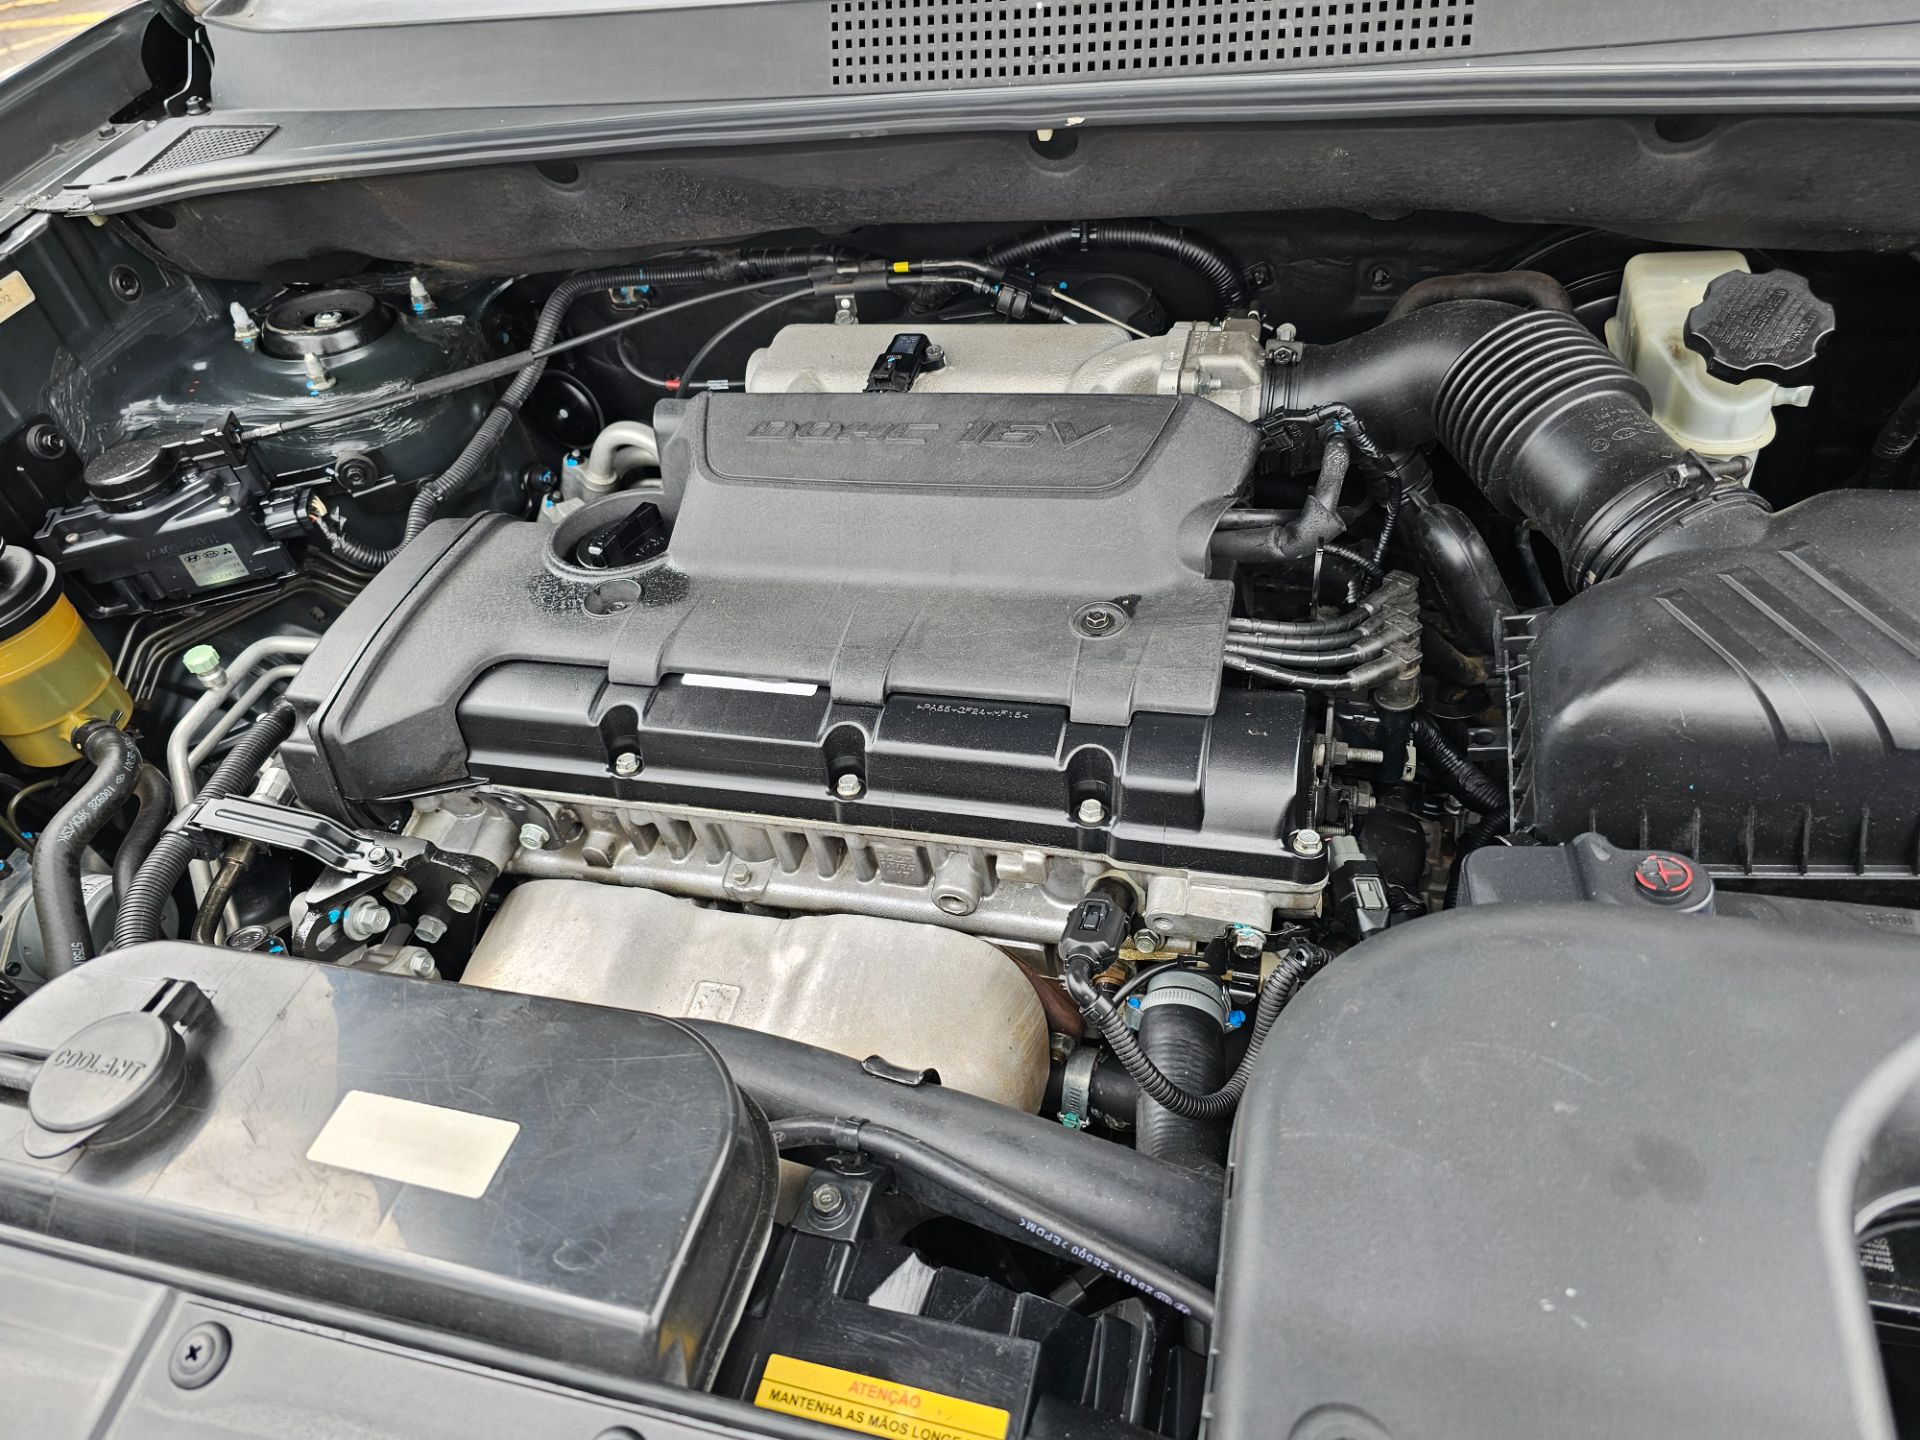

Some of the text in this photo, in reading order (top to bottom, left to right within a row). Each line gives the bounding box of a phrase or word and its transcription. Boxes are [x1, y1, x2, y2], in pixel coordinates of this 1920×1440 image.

[747, 421, 1113, 450] DOHC 16V
[53, 1049, 147, 1080] COOLANT
[848, 1380, 922, 1409] ATENÇÃO
[768, 1389, 843, 1418] MANTENHA
[845, 1409, 865, 1424] AS
[867, 1412, 909, 1435] MÃOS
